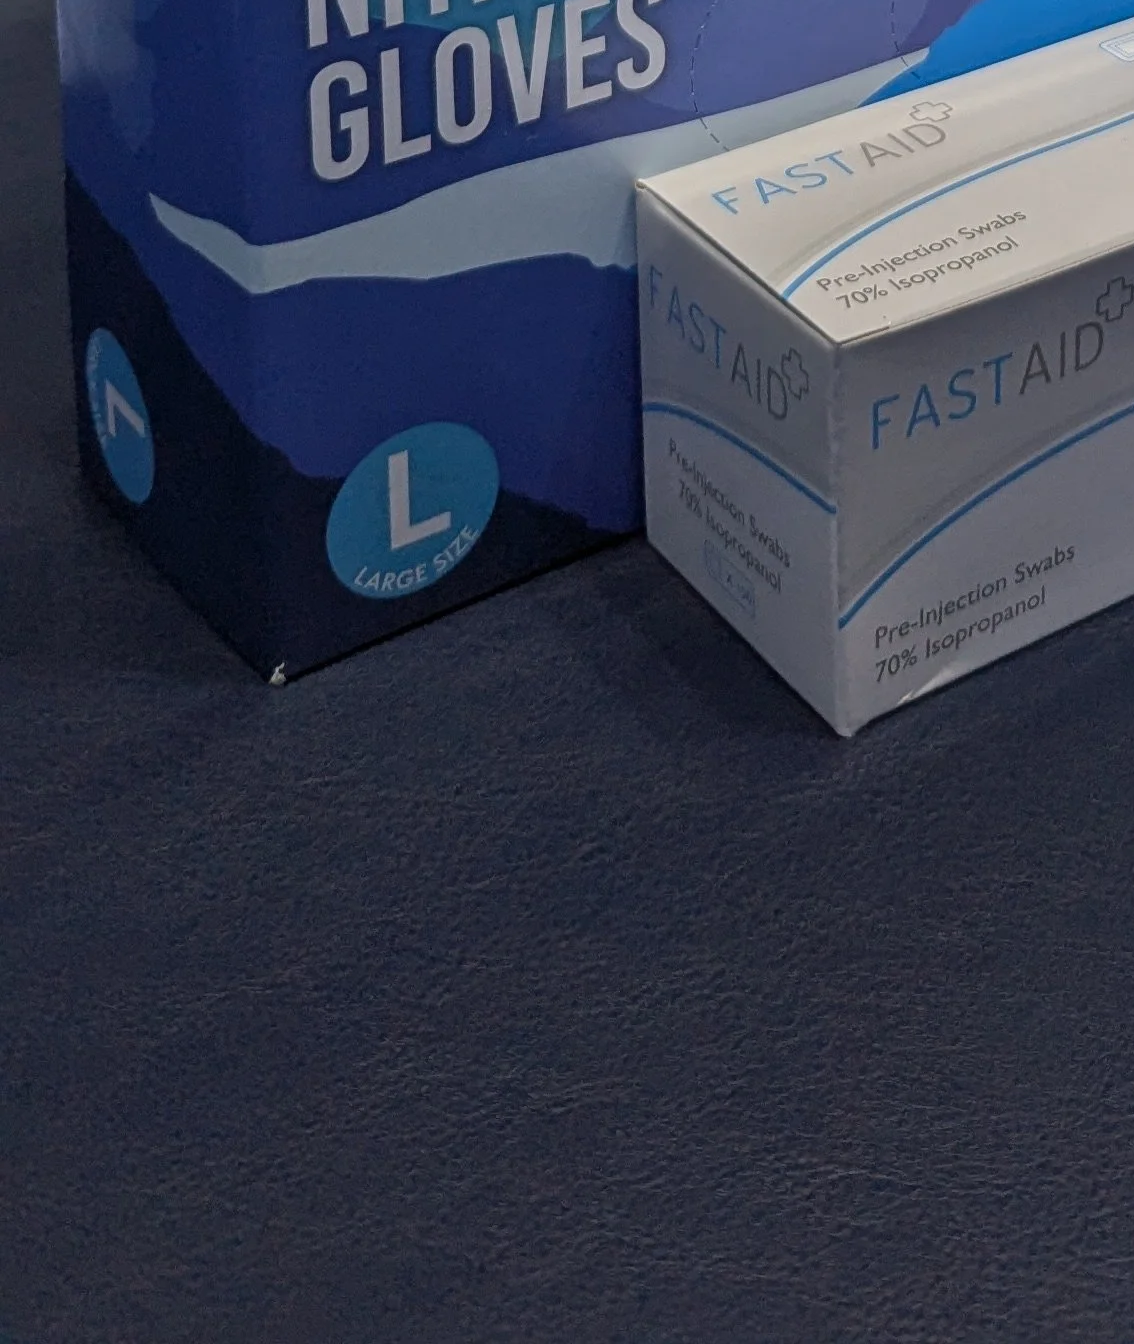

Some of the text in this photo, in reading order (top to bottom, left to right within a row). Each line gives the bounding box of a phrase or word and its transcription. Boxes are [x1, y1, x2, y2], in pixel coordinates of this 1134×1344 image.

[816, 209, 1027, 292] Pre-Injection Swabs
[835, 236, 1020, 311] 70% Isopropanol
[387, 450, 451, 551] L
[749, 513, 791, 568] Swabs
[353, 523, 480, 593] LARGE SIZE
[705, 505, 782, 593] Isopropanol
[875, 545, 1076, 649] Pre-Injection Swabs
[875, 585, 1046, 682] 70% Isopropanol
